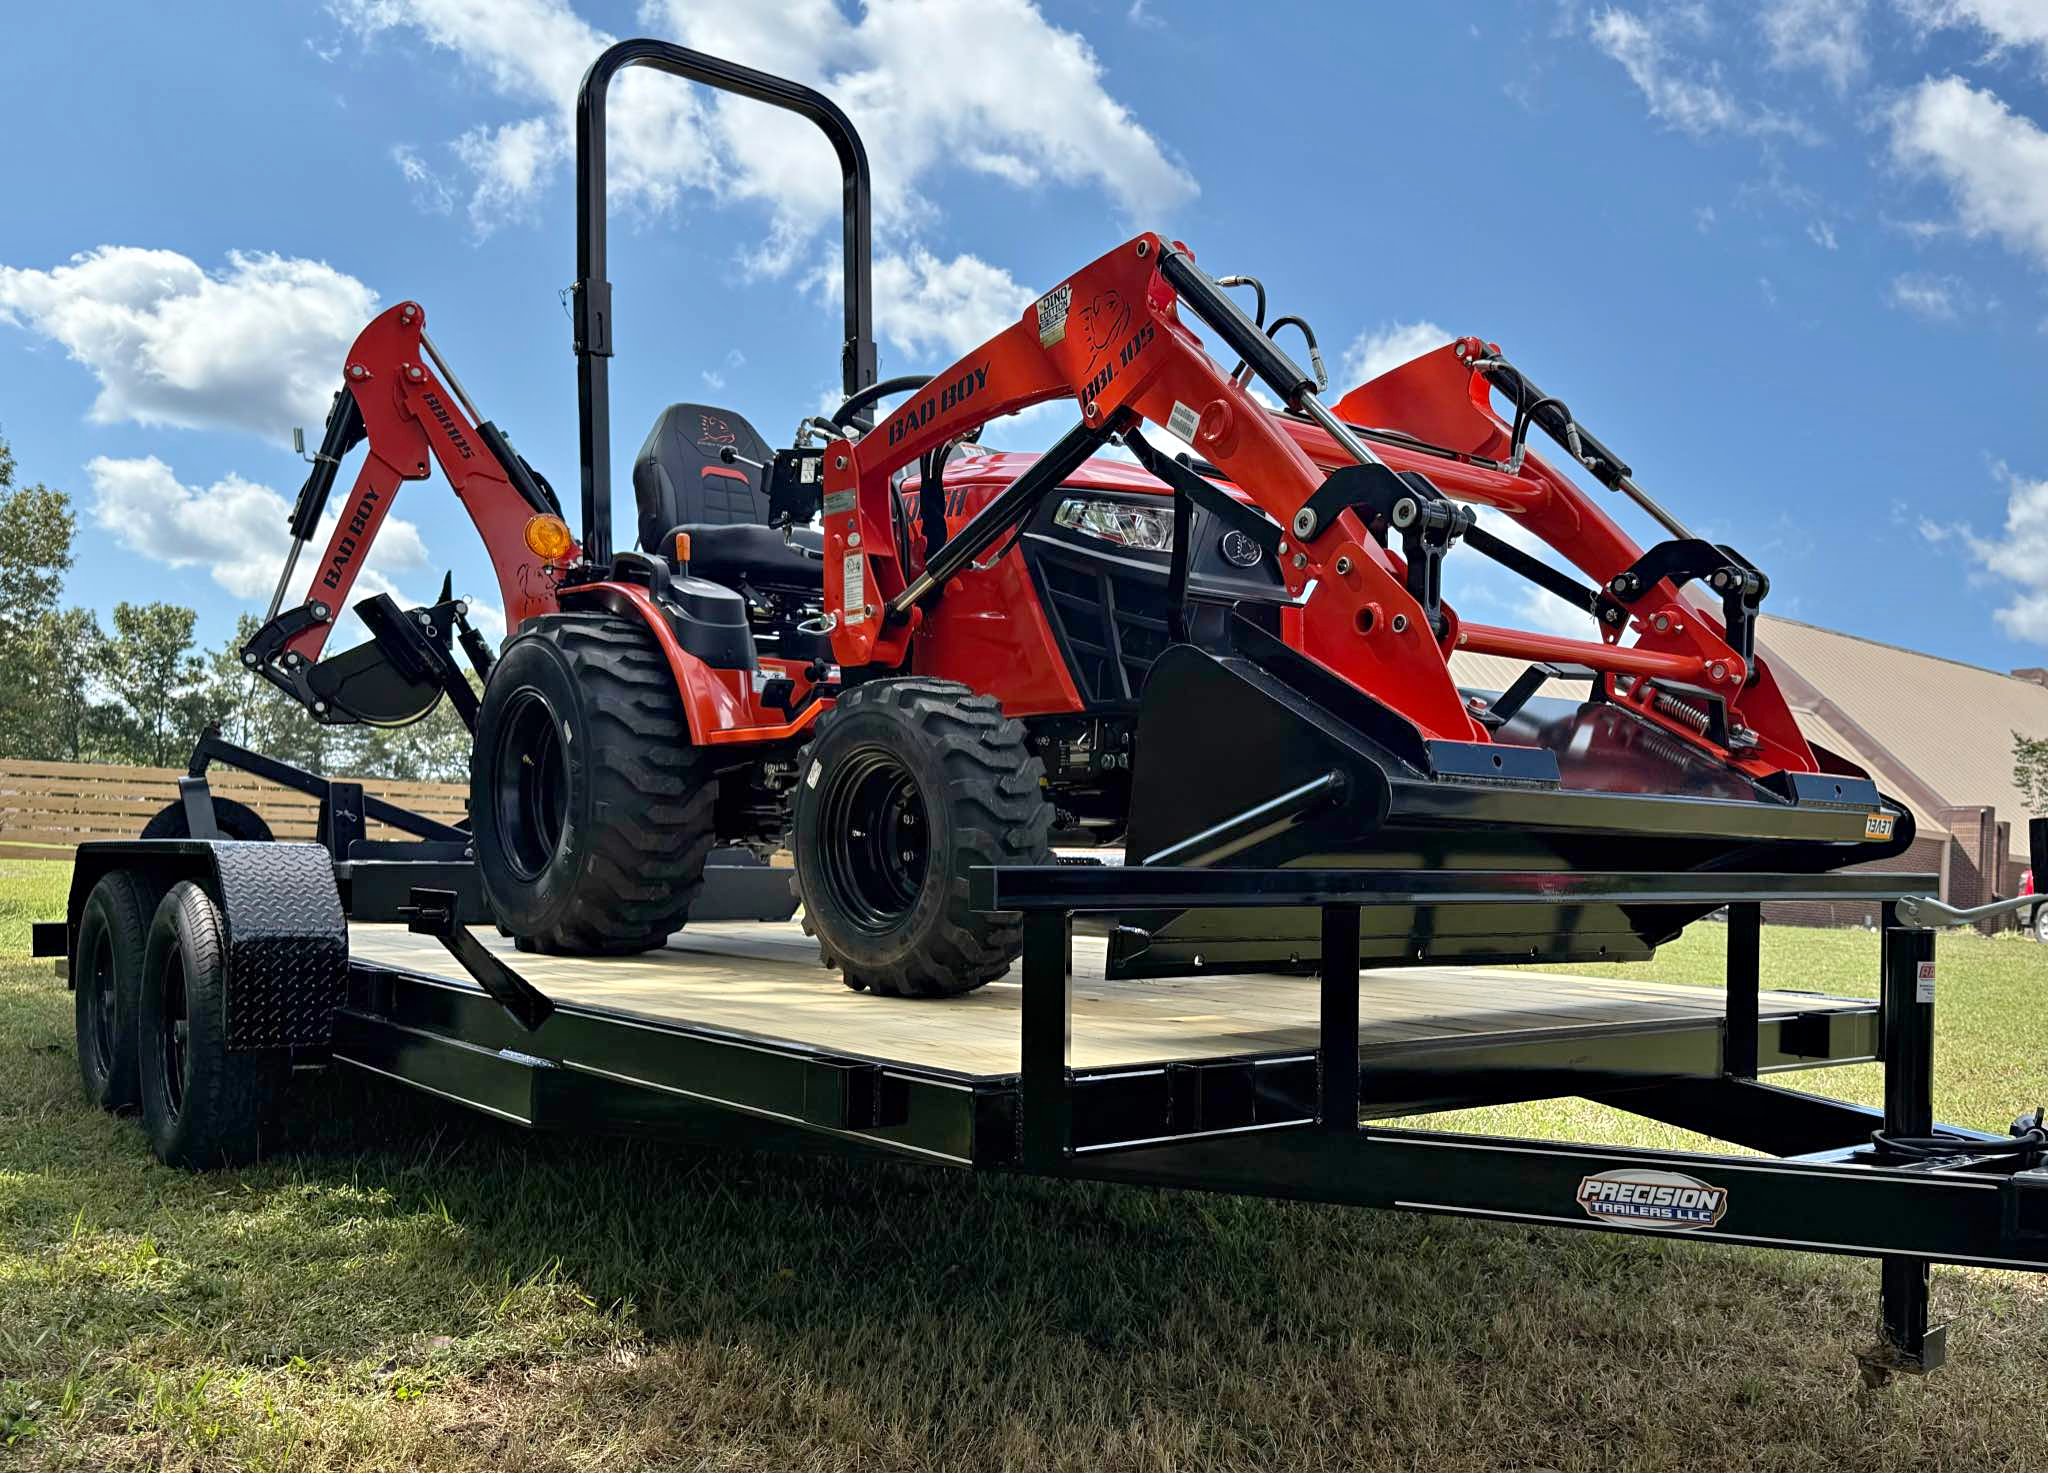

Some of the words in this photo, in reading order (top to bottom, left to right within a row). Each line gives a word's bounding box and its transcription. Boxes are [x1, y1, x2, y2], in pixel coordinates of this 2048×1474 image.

[1040, 299, 1068, 322] EDITION
[1043, 286, 1067, 311] DINO
[1080, 361, 1119, 409] BBL
[1120, 320, 1155, 368] 105
[888, 398, 936, 447] BAD
[941, 360, 991, 413] BOY
[323, 536, 356, 589] BAD
[348, 484, 379, 536] BOY
[1867, 818, 1893, 834] LEVEL
[1581, 1180, 1720, 1210] PRECISION
[1591, 1202, 1672, 1218] TRAILERS
[1676, 1209, 1711, 1222] LLC
